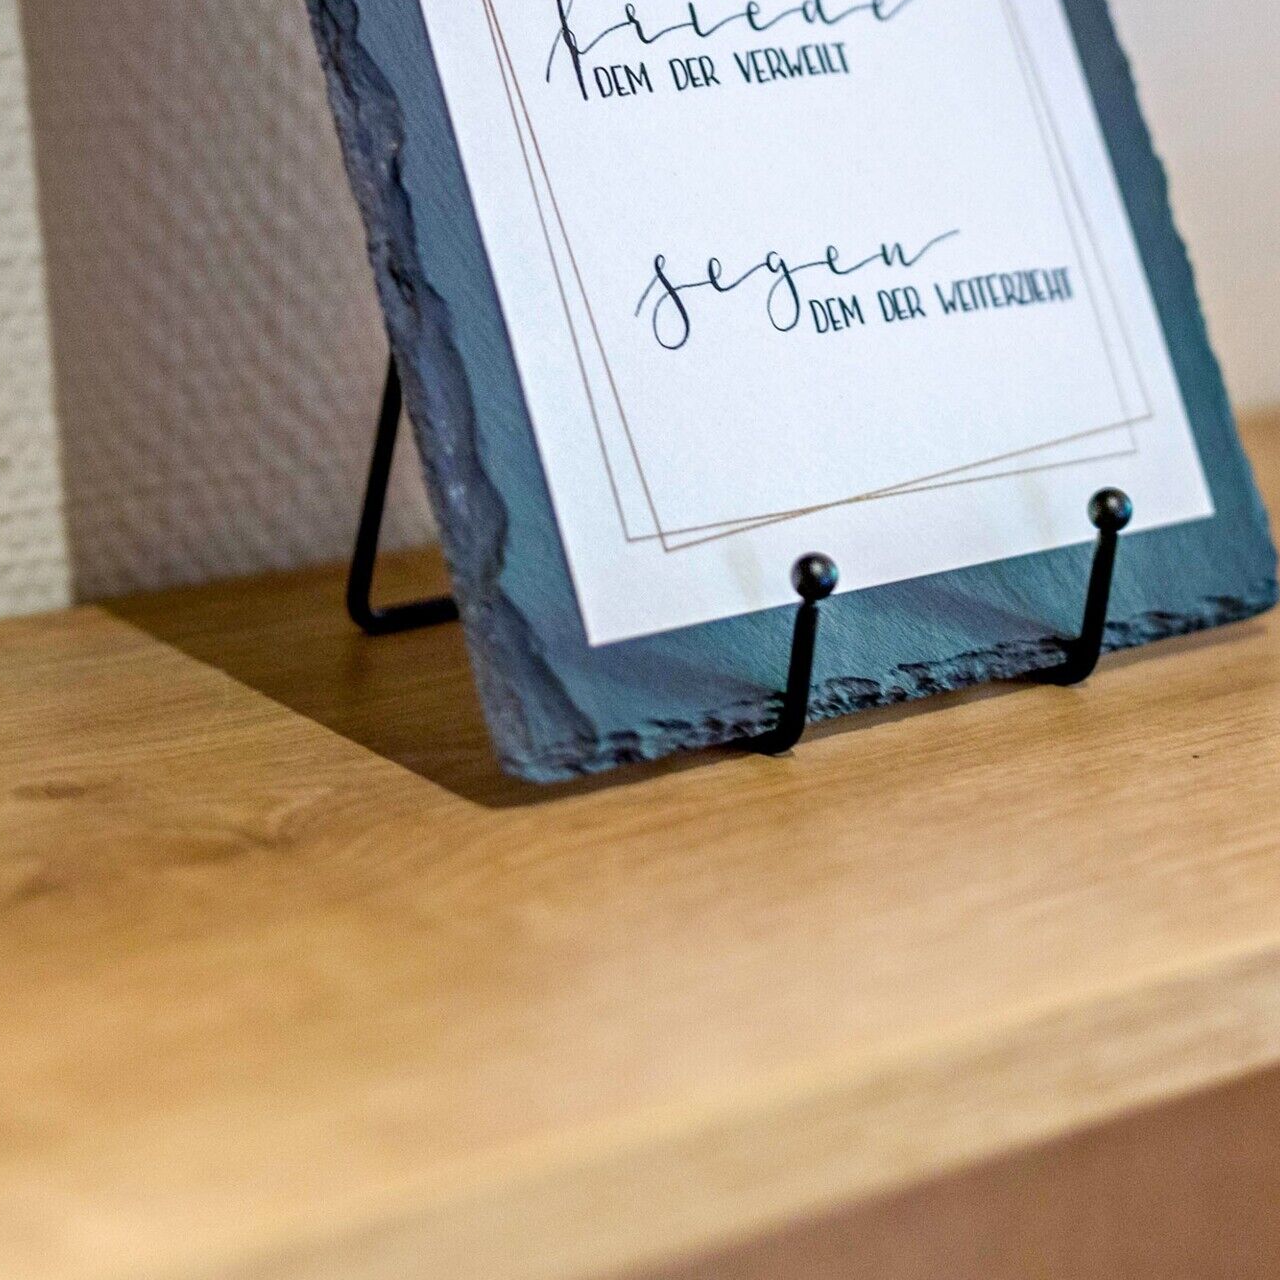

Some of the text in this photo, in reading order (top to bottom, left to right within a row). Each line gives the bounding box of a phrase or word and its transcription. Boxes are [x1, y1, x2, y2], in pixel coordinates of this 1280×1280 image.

[592, 41, 851, 99] DEM DER VERWEILT
[634, 228, 961, 351] segen
[808, 266, 1076, 334] DEM DER WEITERZIEHT
